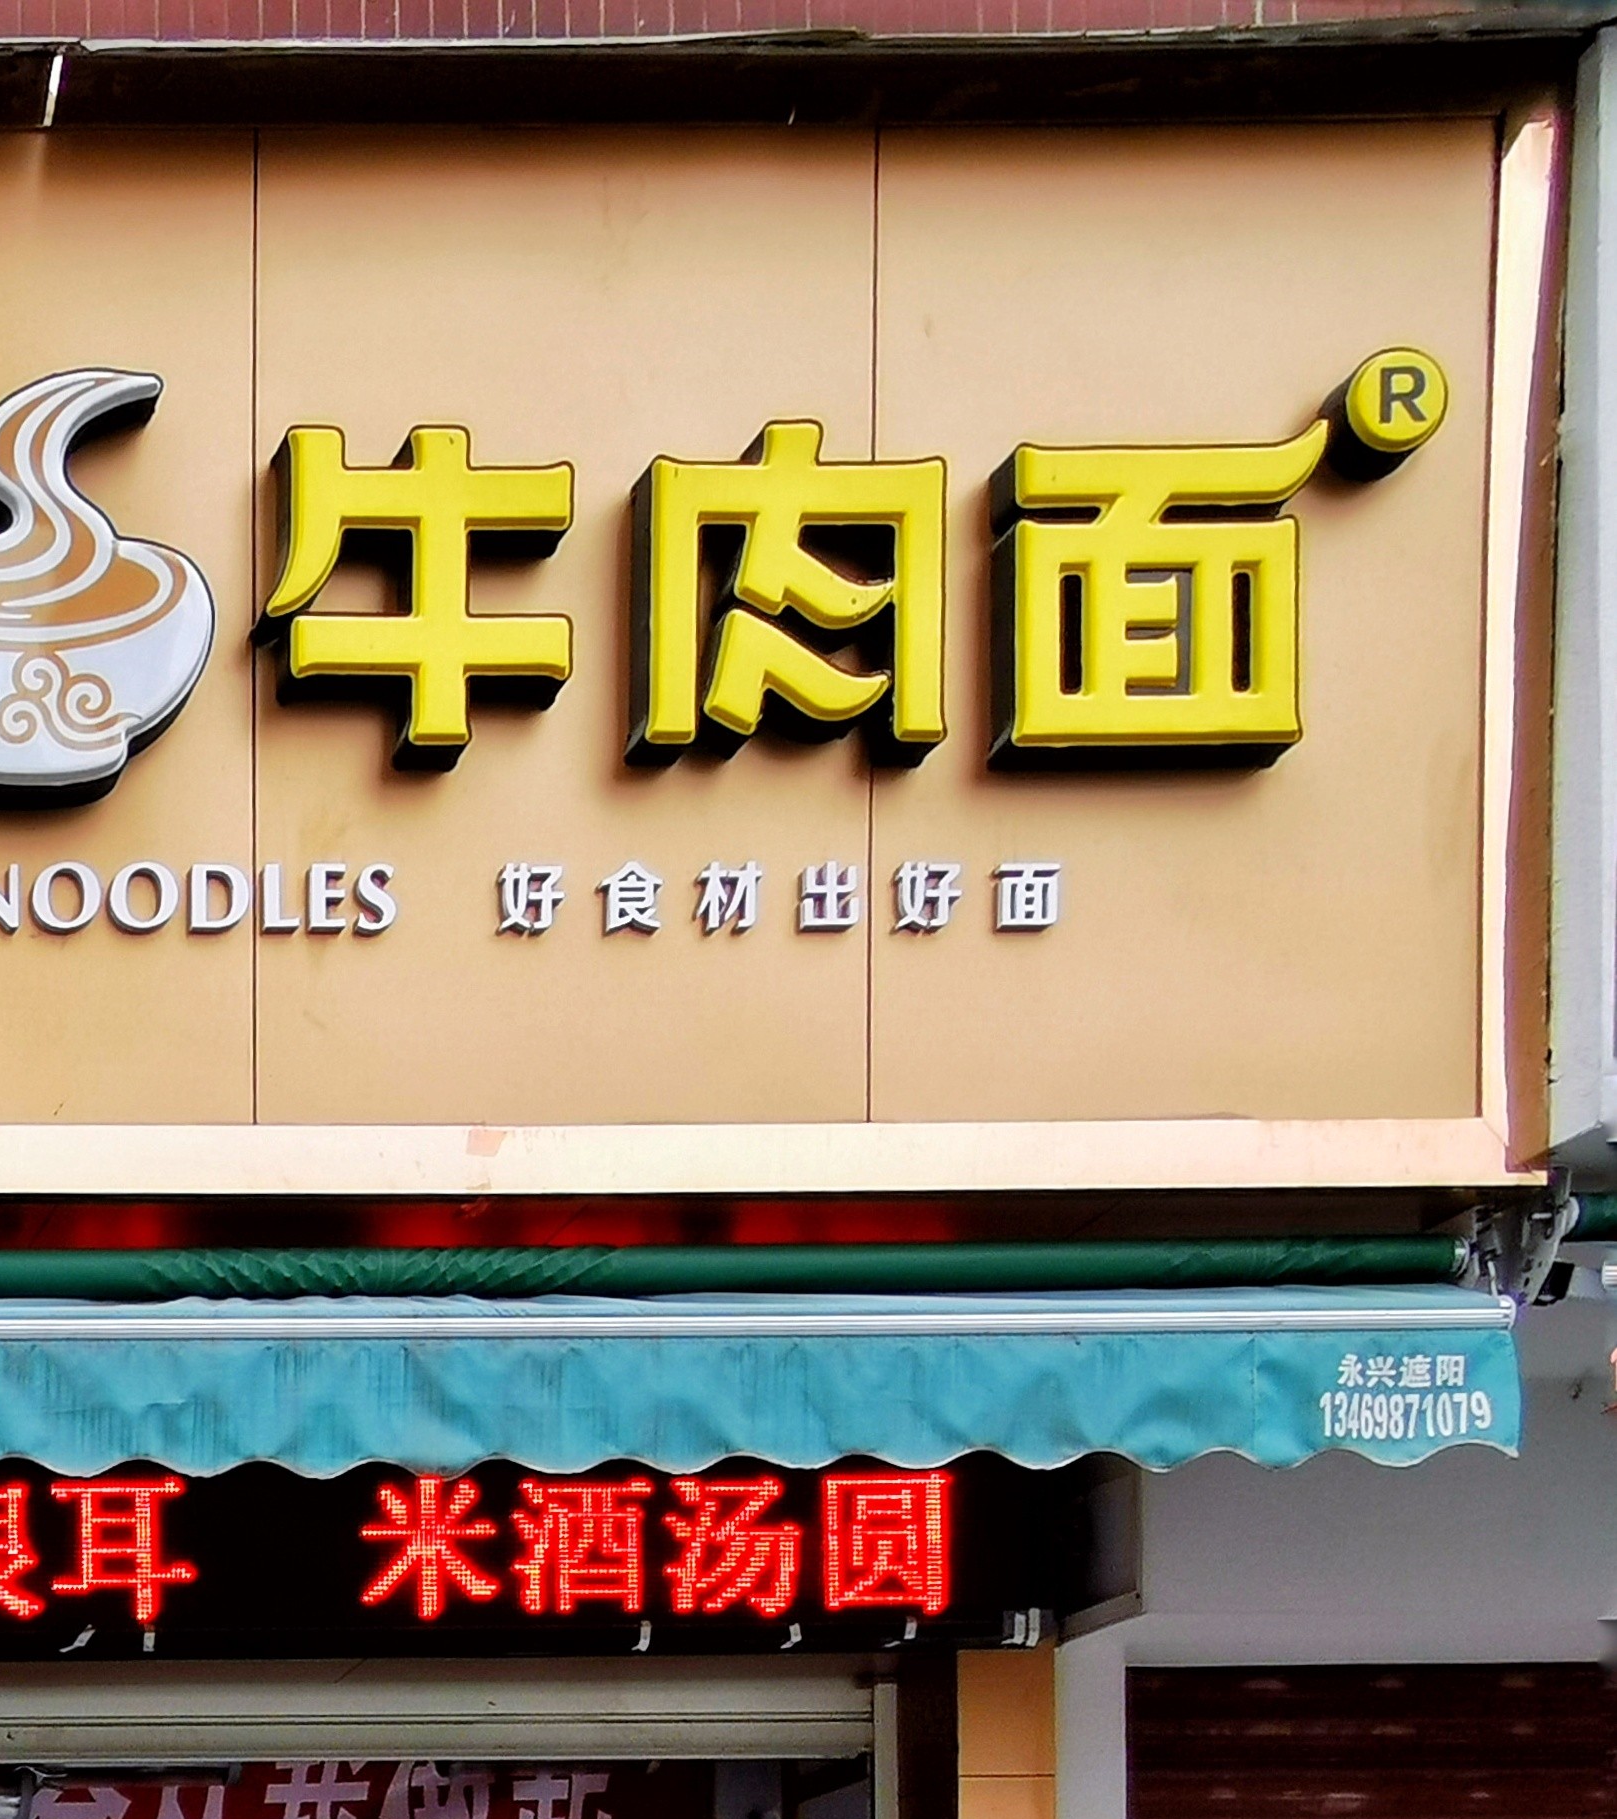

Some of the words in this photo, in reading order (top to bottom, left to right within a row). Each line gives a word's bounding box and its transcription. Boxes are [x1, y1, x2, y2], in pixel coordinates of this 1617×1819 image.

[495, 860, 1065, 936] 好食材出好面
[1337, 1354, 1465, 1389] 永兴遮阳
[1320, 1391, 1493, 1440] 13469871079
[359, 1472, 955, 1618] 米酒汤圆
